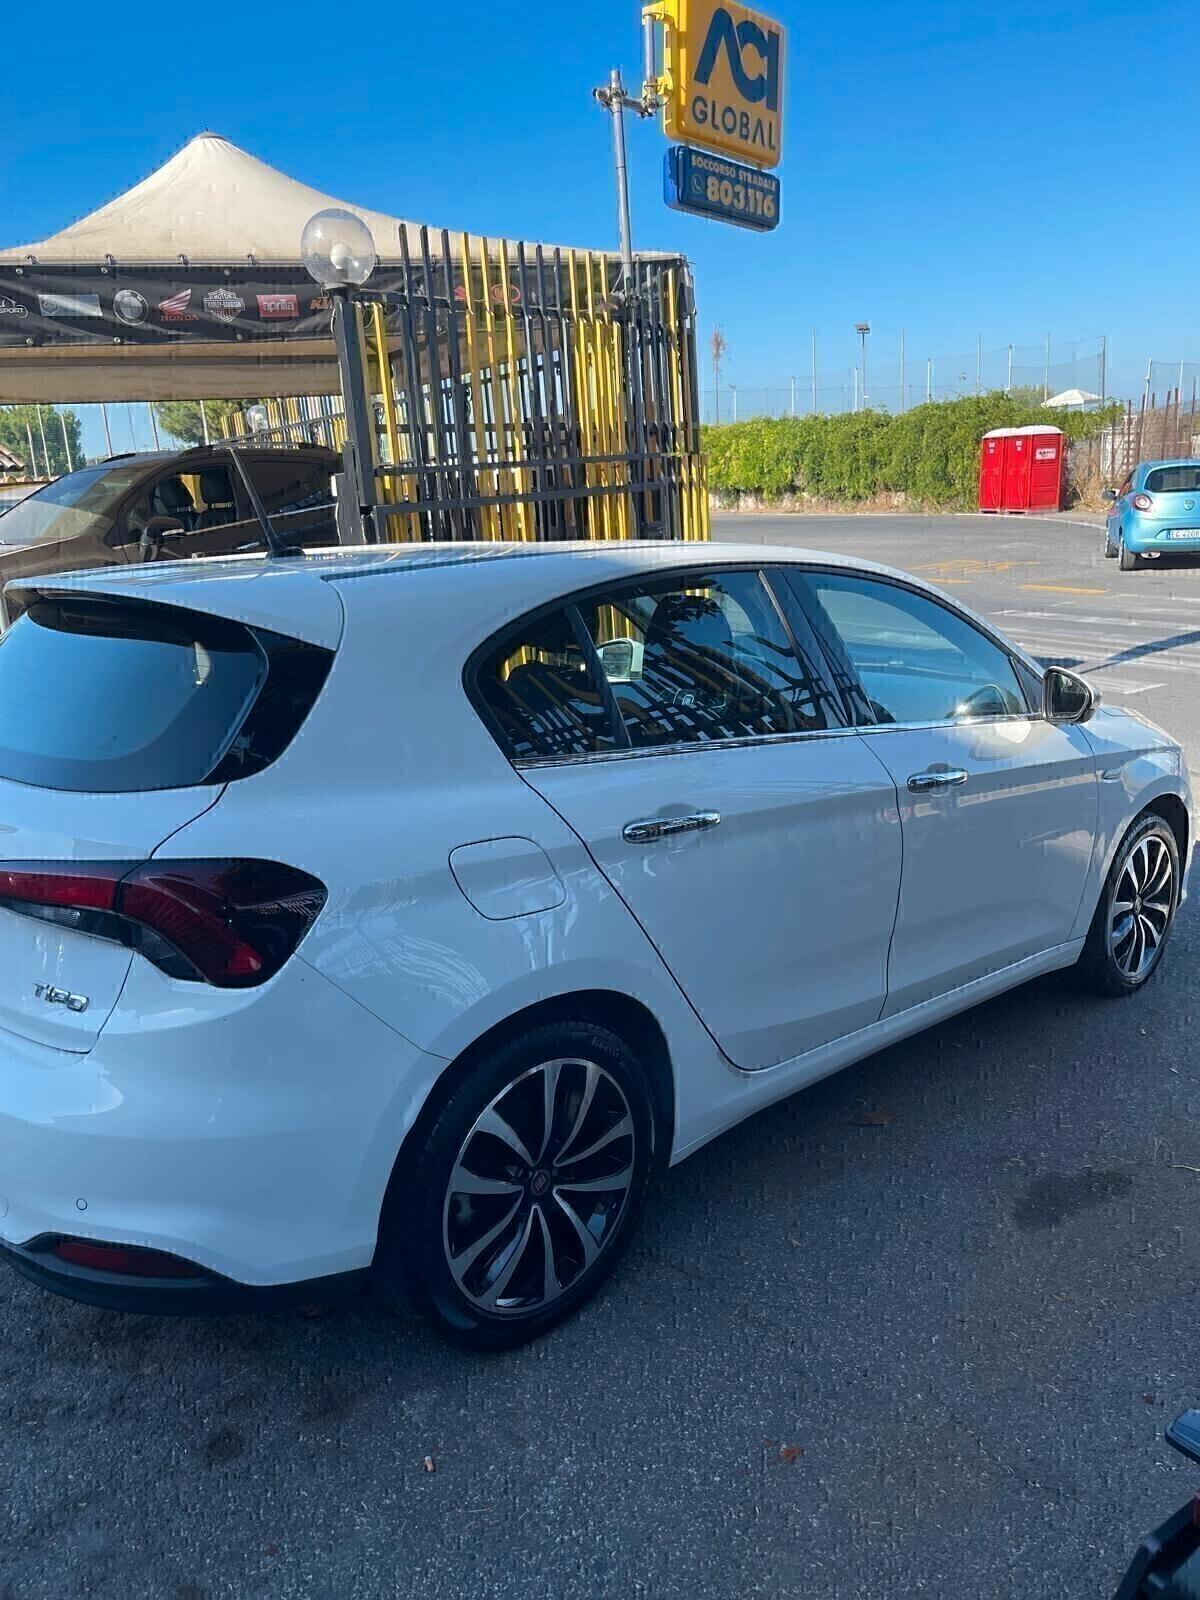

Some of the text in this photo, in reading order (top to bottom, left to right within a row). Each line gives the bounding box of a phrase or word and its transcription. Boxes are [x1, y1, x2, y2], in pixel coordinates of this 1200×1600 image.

[693, 7, 780, 113] ACI
[691, 95, 776, 151] GLOBAL
[691, 152, 776, 192] SOCCORSO STRADALE
[262, 298, 295, 313] aprilia
